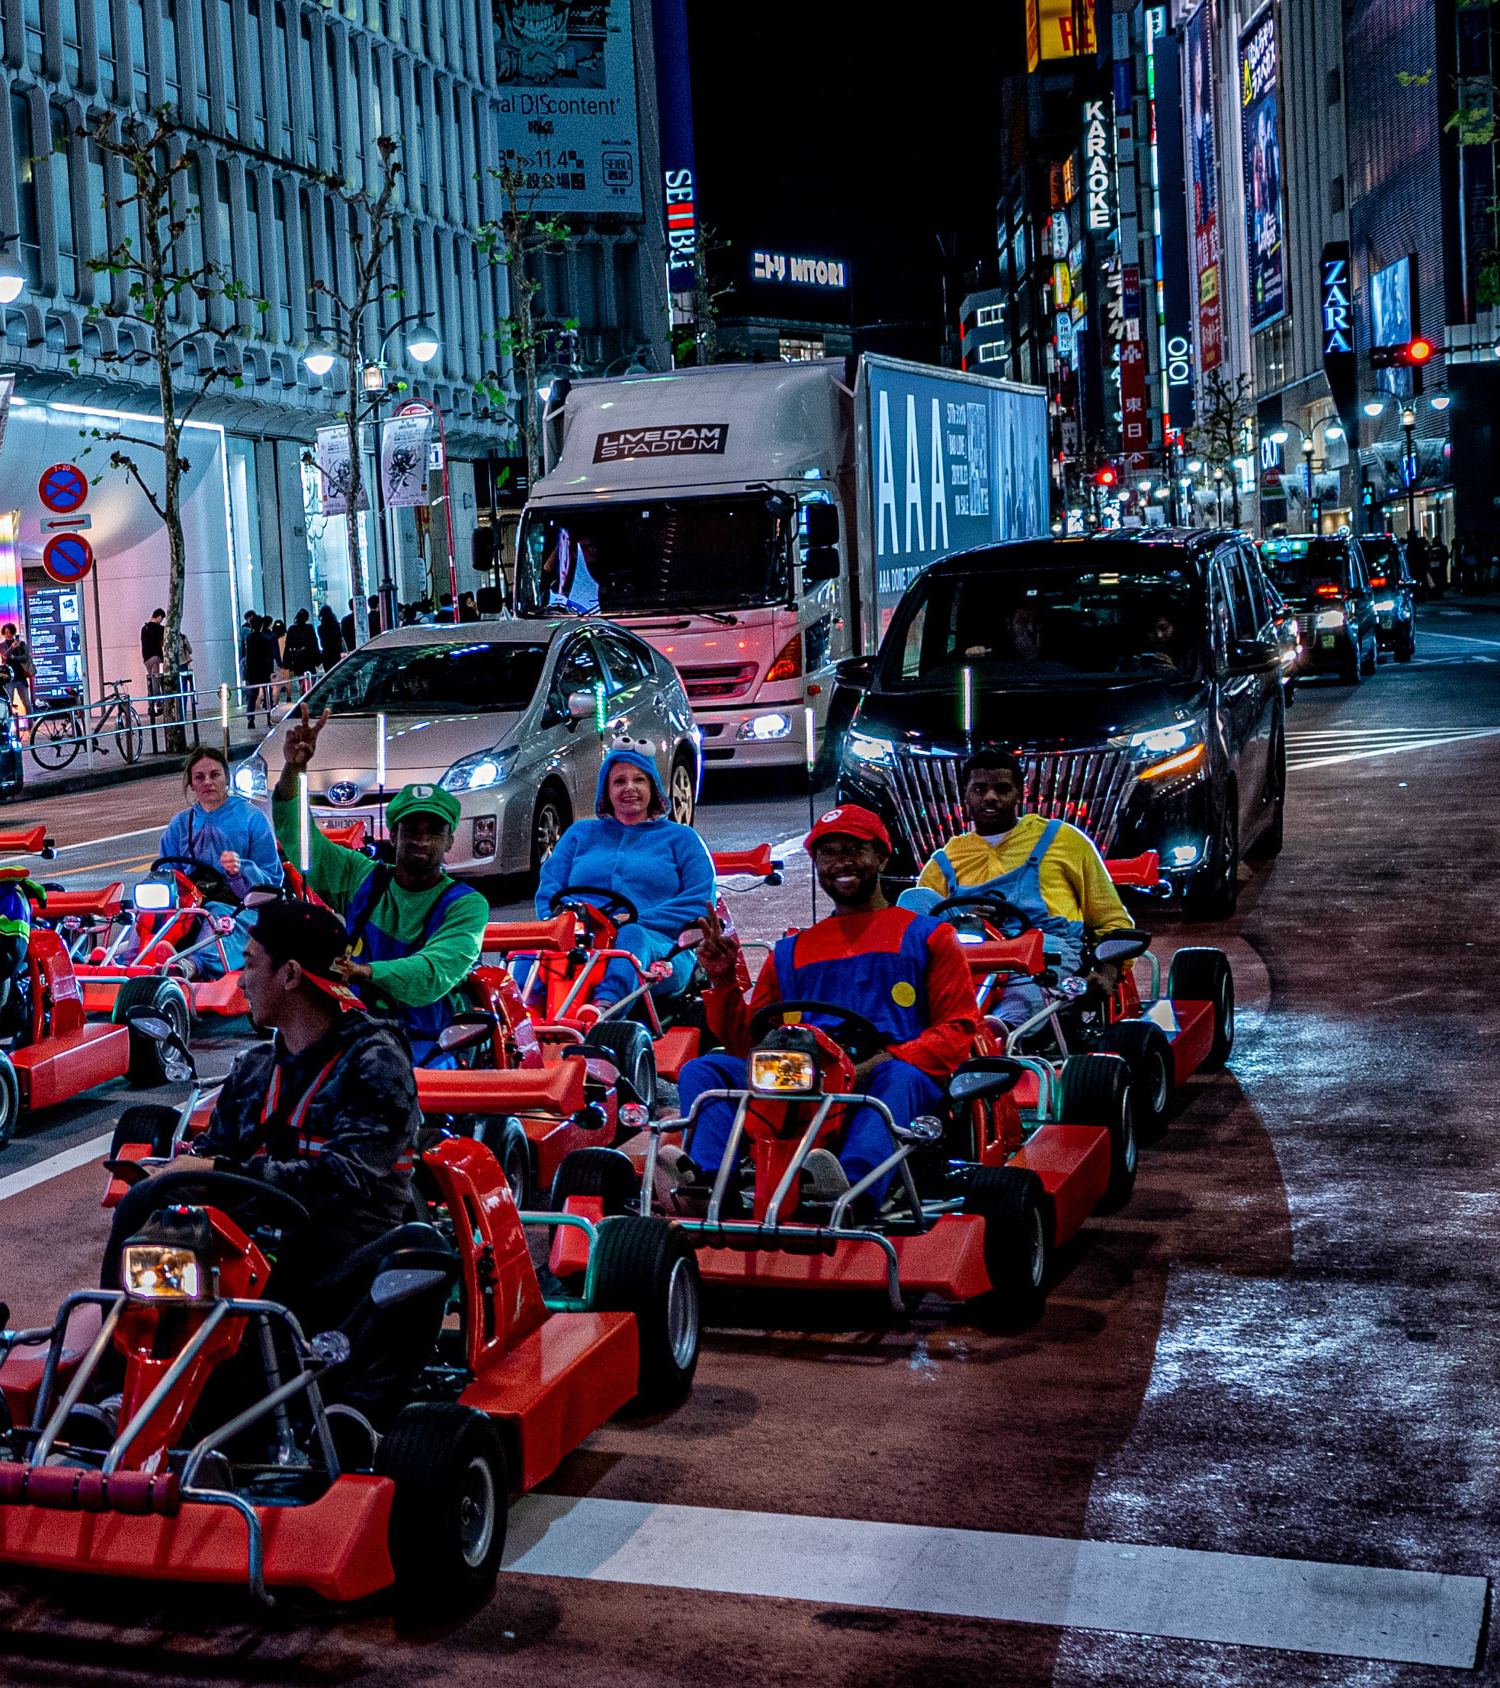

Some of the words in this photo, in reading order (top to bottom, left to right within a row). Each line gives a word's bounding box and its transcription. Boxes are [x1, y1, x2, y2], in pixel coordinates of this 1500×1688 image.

[1084, 101, 1111, 229] KARAOKE
[754, 253, 786, 280] ニトリ
[791, 256, 845, 287] NITORI
[1324, 260, 1351, 353] ZARA
[601, 439, 719, 459] STADIUM
